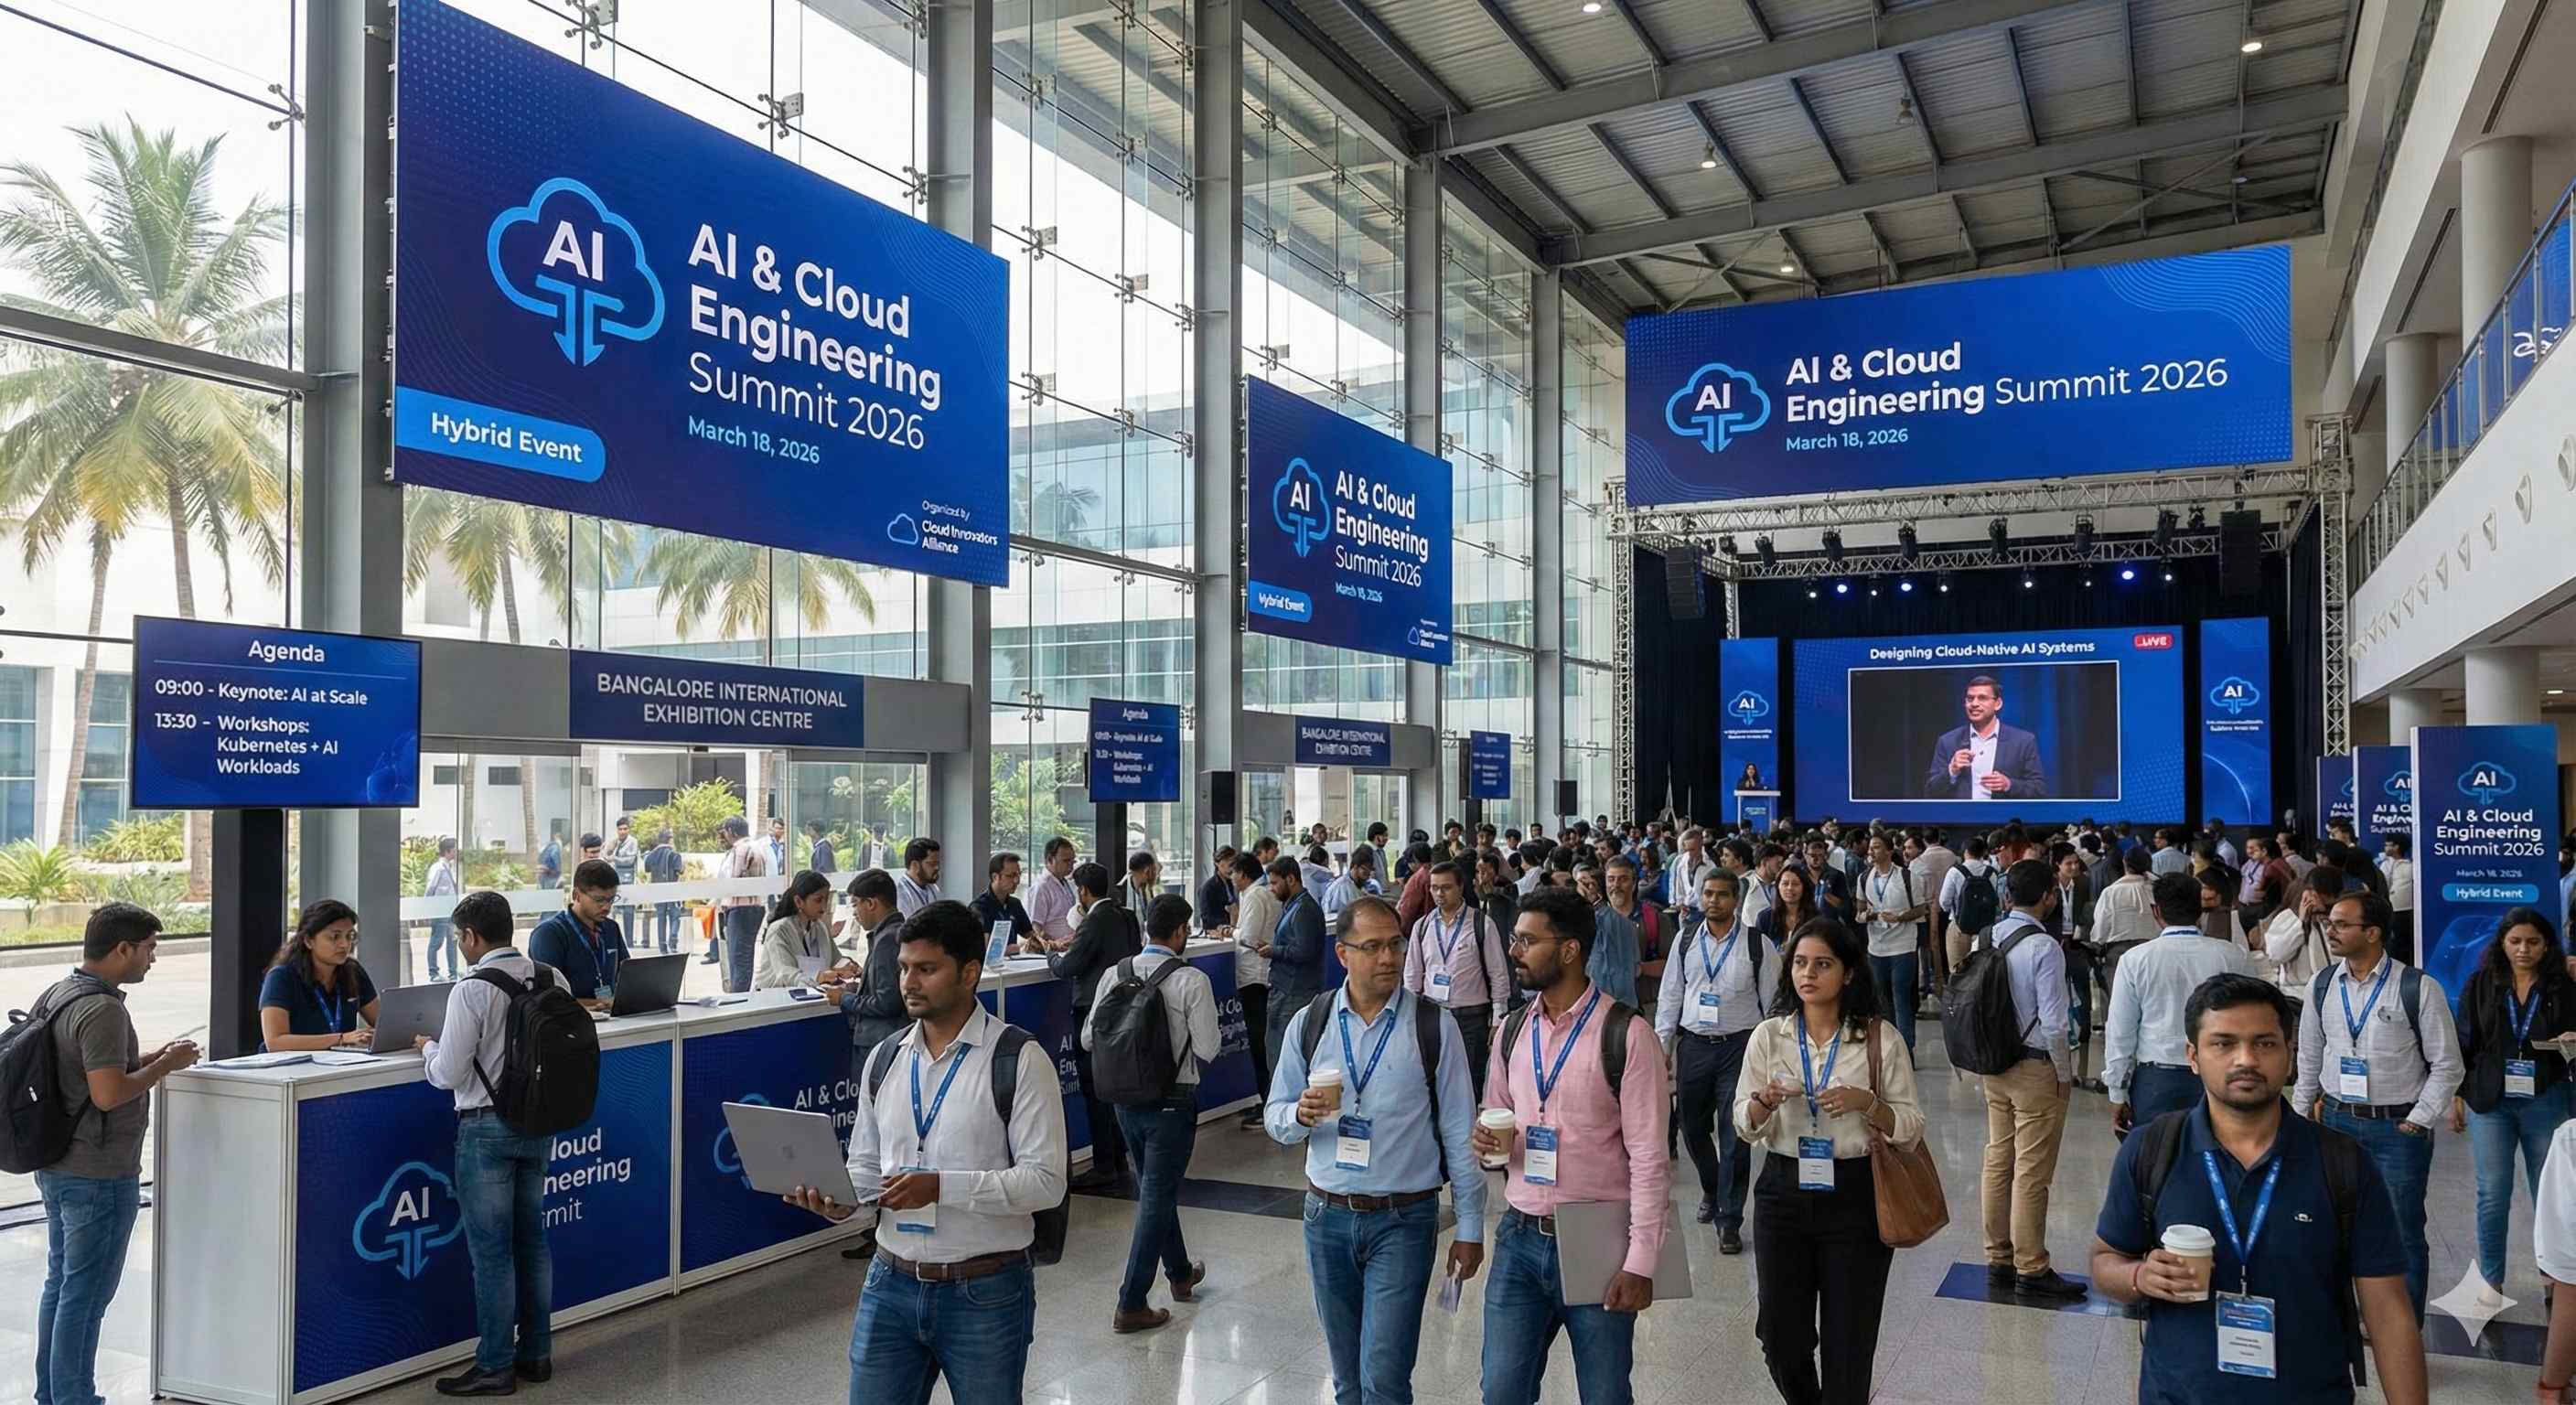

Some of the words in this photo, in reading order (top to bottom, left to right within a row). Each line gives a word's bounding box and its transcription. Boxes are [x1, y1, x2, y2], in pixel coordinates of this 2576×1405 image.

[542, 220, 604, 282] AI
[688, 223, 736, 280] AI
[752, 245, 782, 295] &
[795, 261, 909, 338] Cloud
[692, 284, 940, 411] Engineering
[1786, 356, 1819, 385] AI
[1830, 353, 1852, 381] &
[1862, 341, 1961, 378] Cloud
[689, 351, 839, 428] Summit
[847, 397, 924, 449] 2026
[1695, 382, 1731, 412] AI
[1787, 381, 1984, 425] Engineering
[1995, 366, 2131, 404] Summit
[2140, 358, 2228, 393] 2026
[431, 412, 512, 449] Hybrid
[519, 431, 583, 463] Event
[688, 415, 746, 447] March
[751, 431, 776, 457] 18,
[778, 438, 820, 464] 2026
[1786, 434, 1837, 452] March
[1841, 431, 1863, 448] 18,
[1867, 428, 1909, 445] 2026
[1290, 480, 1310, 512] AI
[1336, 470, 1353, 500] AI
[1358, 477, 1368, 506] &
[1372, 482, 1415, 520] Cloud
[1336, 506, 1428, 563] Engineering
[1336, 544, 1390, 579] Summit
[1391, 560, 1422, 588] 2026
[249, 639, 326, 663] Agenda
[2021, 642, 2035, 653] AI
[2038, 641, 2095, 656] Systems
[155, 679, 204, 696] 09:00
[219, 682, 289, 703] Keynote:
[291, 690, 307, 702] AI
[311, 691, 327, 703] at
[329, 690, 369, 705] Scale
[597, 672, 714, 700] BANGALORE
[719, 682, 847, 708] INTERNATIONAL
[1738, 698, 1755, 709] AI
[2224, 685, 2242, 697] AI
[155, 713, 197, 729] 13:30
[218, 715, 310, 735] Workshops:
[644, 703, 746, 726] EXHIBITION
[750, 710, 813, 729] CENTRE
[217, 737, 307, 754] Kubernetes
[310, 744, 319, 752] +
[322, 741, 338, 755] AI
[217, 758, 301, 775] Workloads
[2473, 770, 2496, 787] AI
[2442, 810, 2461, 822] AI
[2466, 810, 2478, 822] &
[2482, 809, 2533, 822] Cloud
[2434, 842, 2500, 856] Summit
[2503, 842, 2545, 856] 2026
[2436, 825, 2541, 842] Engineering
[1059, 1034, 1073, 1053] AI
[794, 1088, 811, 1110] AI
[819, 1085, 830, 1105] &
[834, 1078, 860, 1100] Clo
[550, 1127, 601, 1162] loud
[543, 1157, 630, 1196] neering
[391, 1186, 429, 1226] AI
